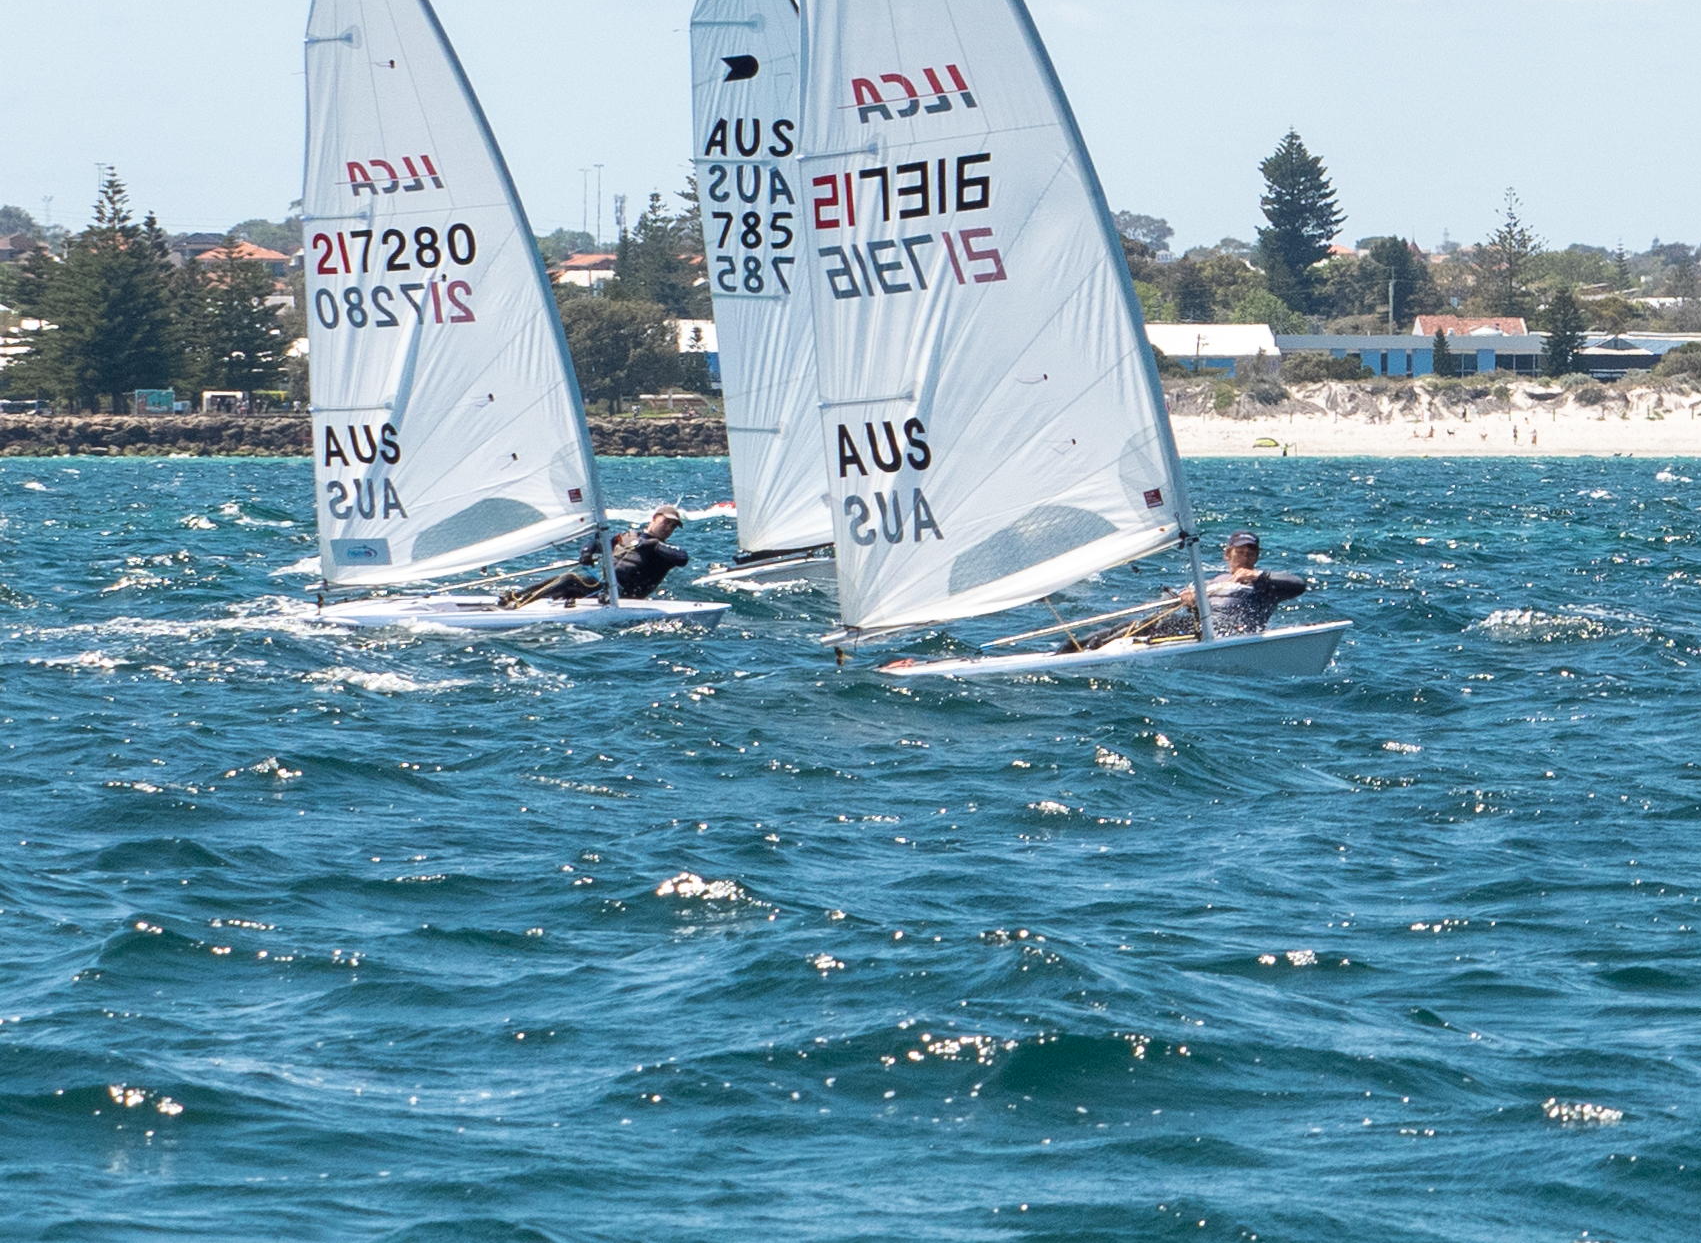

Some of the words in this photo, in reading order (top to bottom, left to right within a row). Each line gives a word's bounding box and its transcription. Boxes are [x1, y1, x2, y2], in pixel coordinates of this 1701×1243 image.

[704, 117, 795, 157] AUS
[812, 153, 992, 230] 217316
[312, 223, 477, 275] 217280
[711, 211, 794, 249] 785
[325, 422, 402, 467] AUS
[837, 417, 932, 478] AUS
